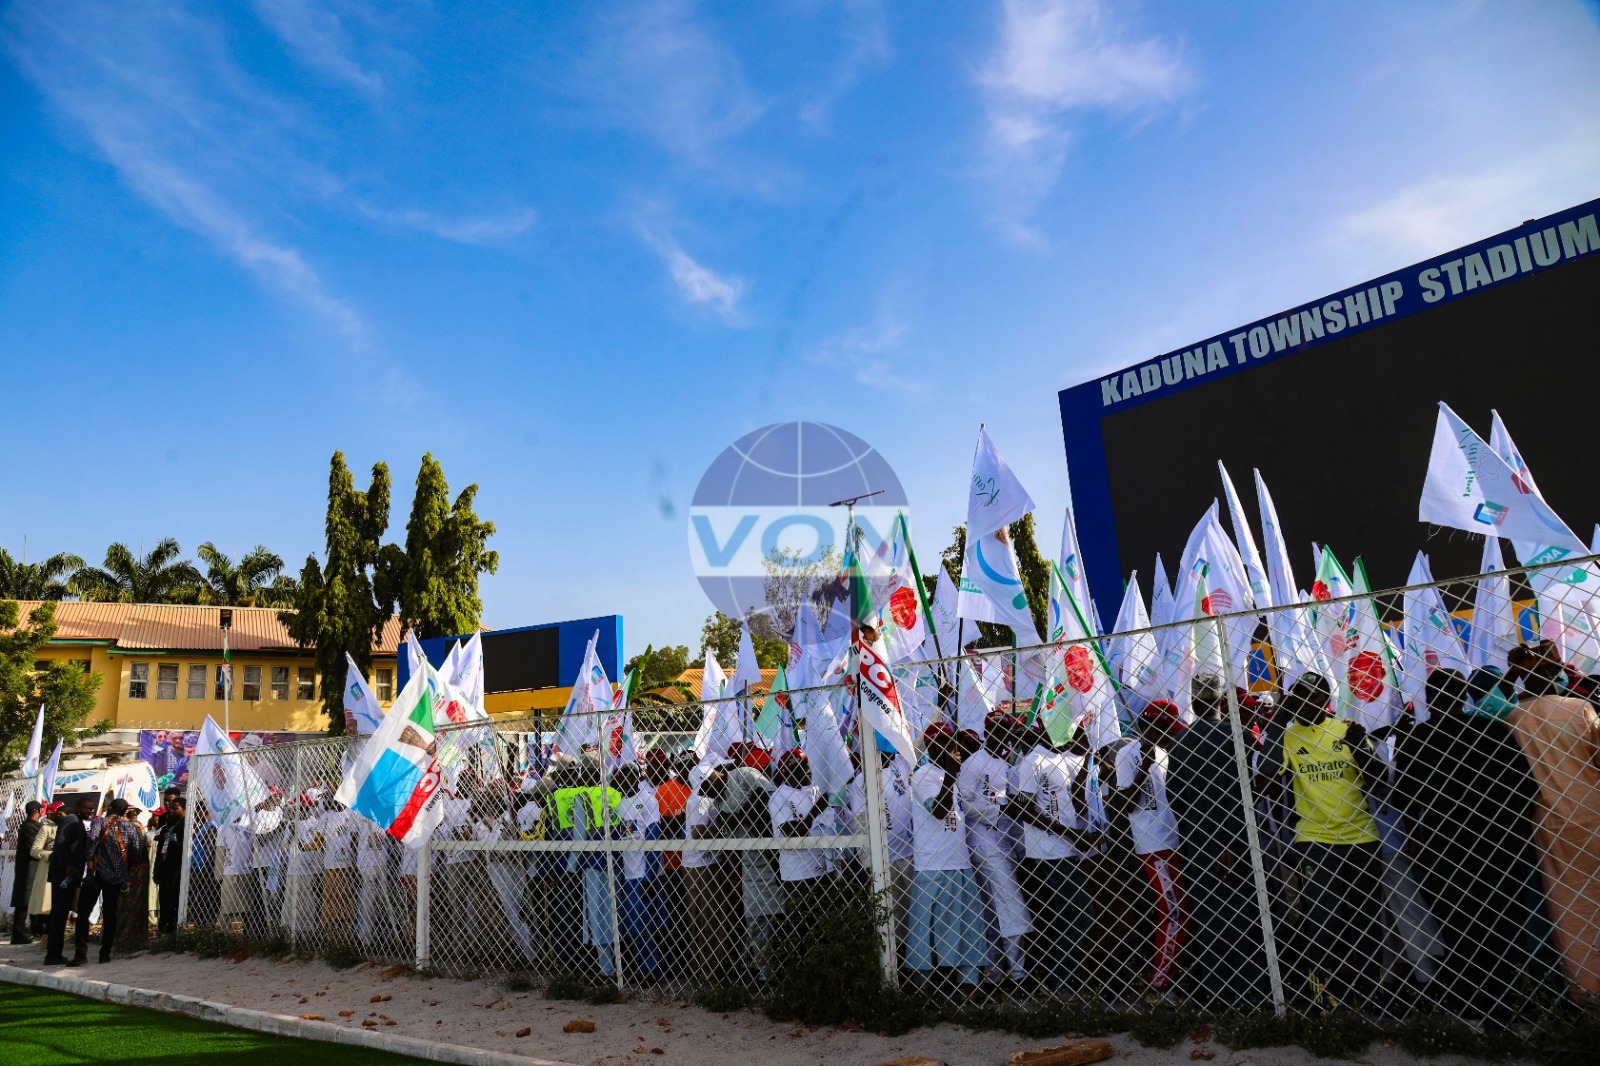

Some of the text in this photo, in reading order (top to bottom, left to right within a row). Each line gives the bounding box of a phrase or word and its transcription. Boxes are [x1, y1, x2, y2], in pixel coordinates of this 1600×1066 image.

[1100, 213, 1600, 407] KADUNA TOWNSHIP STADIUM
[860, 681, 892, 715] Congress
[1298, 760, 1350, 774] Emirates
